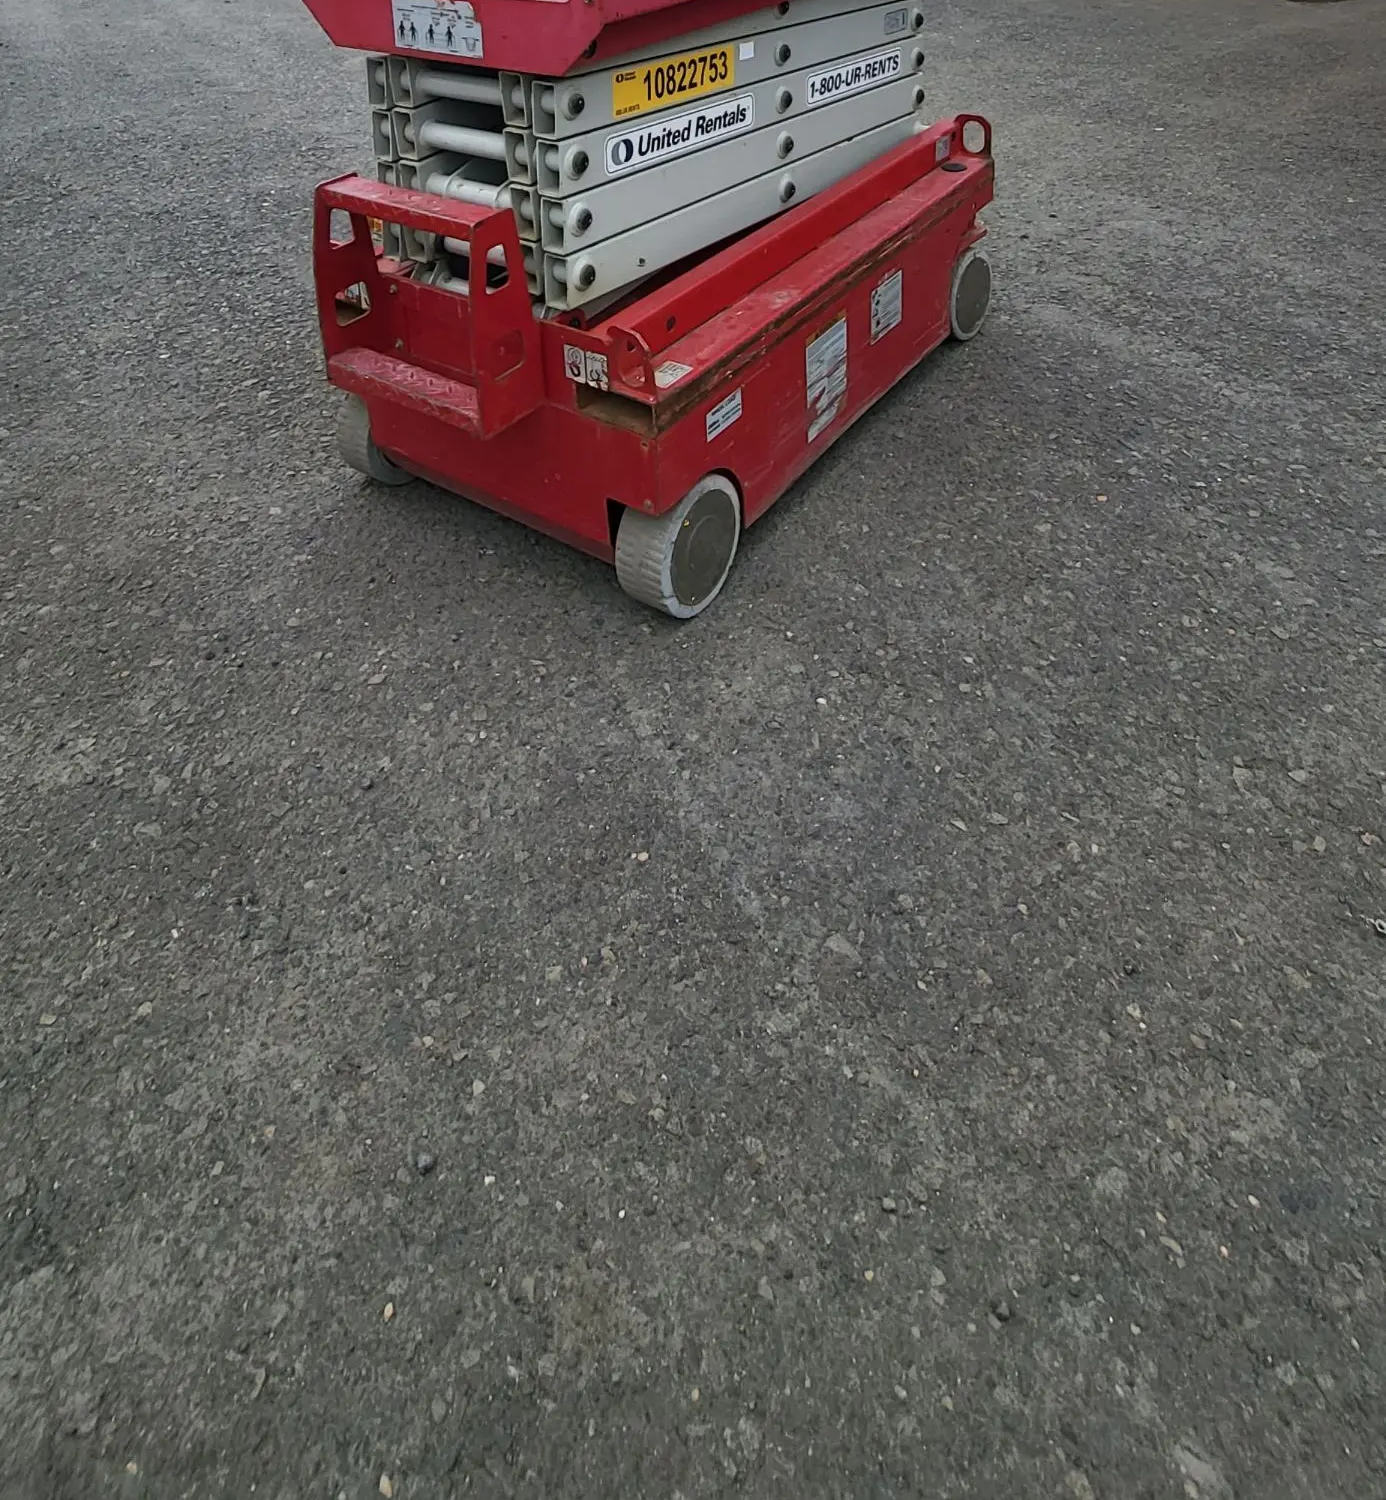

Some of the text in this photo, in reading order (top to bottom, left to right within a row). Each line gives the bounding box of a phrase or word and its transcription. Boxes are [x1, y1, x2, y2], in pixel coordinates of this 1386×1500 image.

[643, 51, 728, 102] 10822753
[810, 54, 900, 98] 1-800-UR-RENTS
[638, 103, 747, 156] United Rentals
